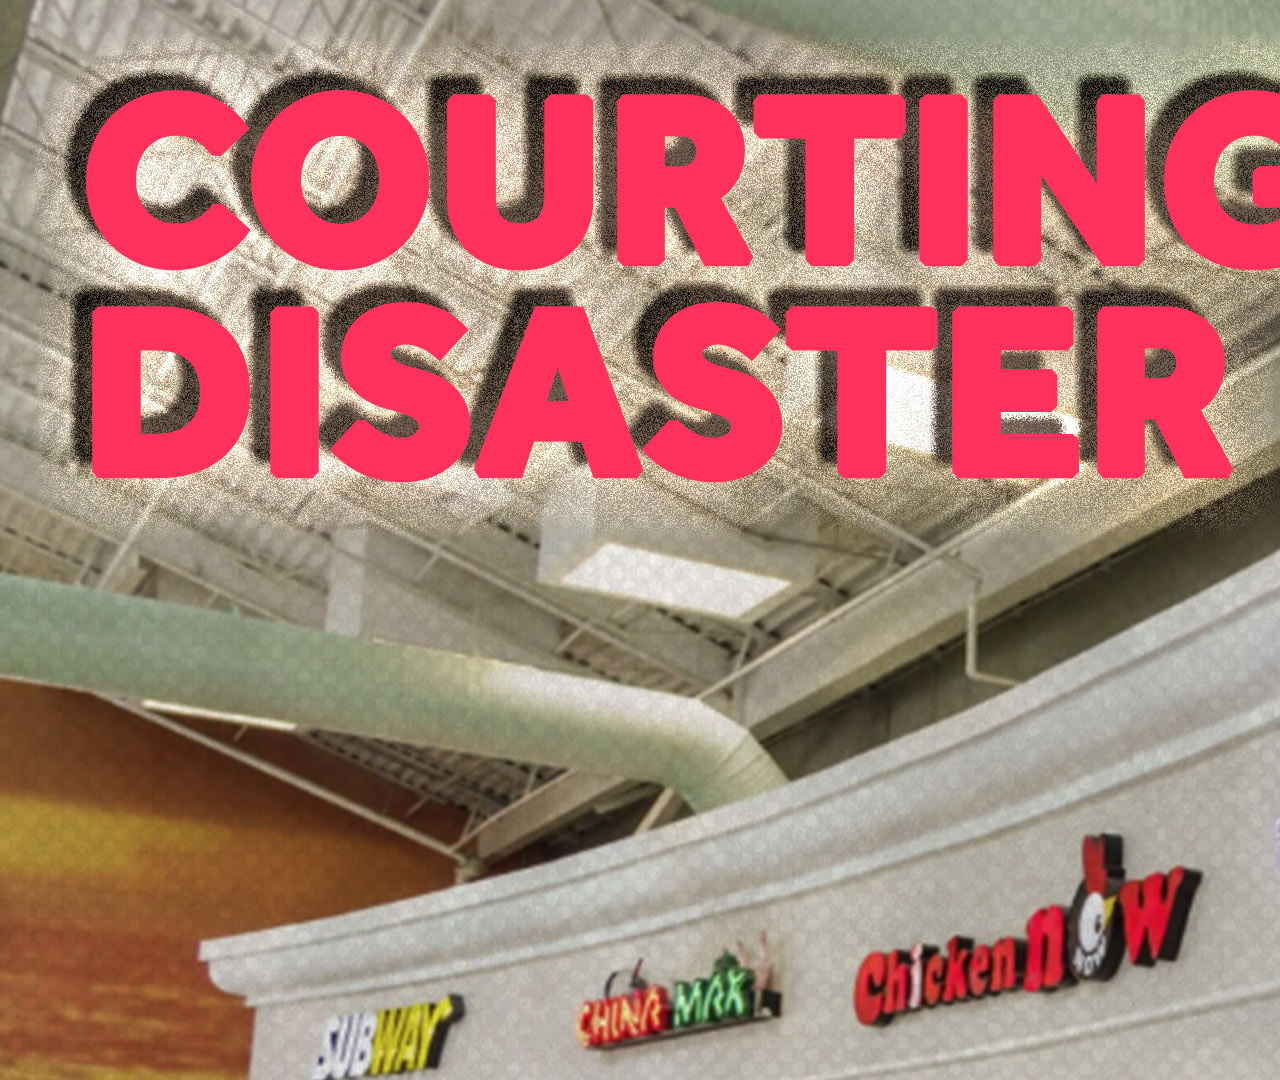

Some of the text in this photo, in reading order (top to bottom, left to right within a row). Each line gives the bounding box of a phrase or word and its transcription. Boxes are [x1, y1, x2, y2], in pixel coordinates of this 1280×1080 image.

[576, 967, 756, 1048] CHINA MAX
[852, 935, 1026, 1027] Chicken
